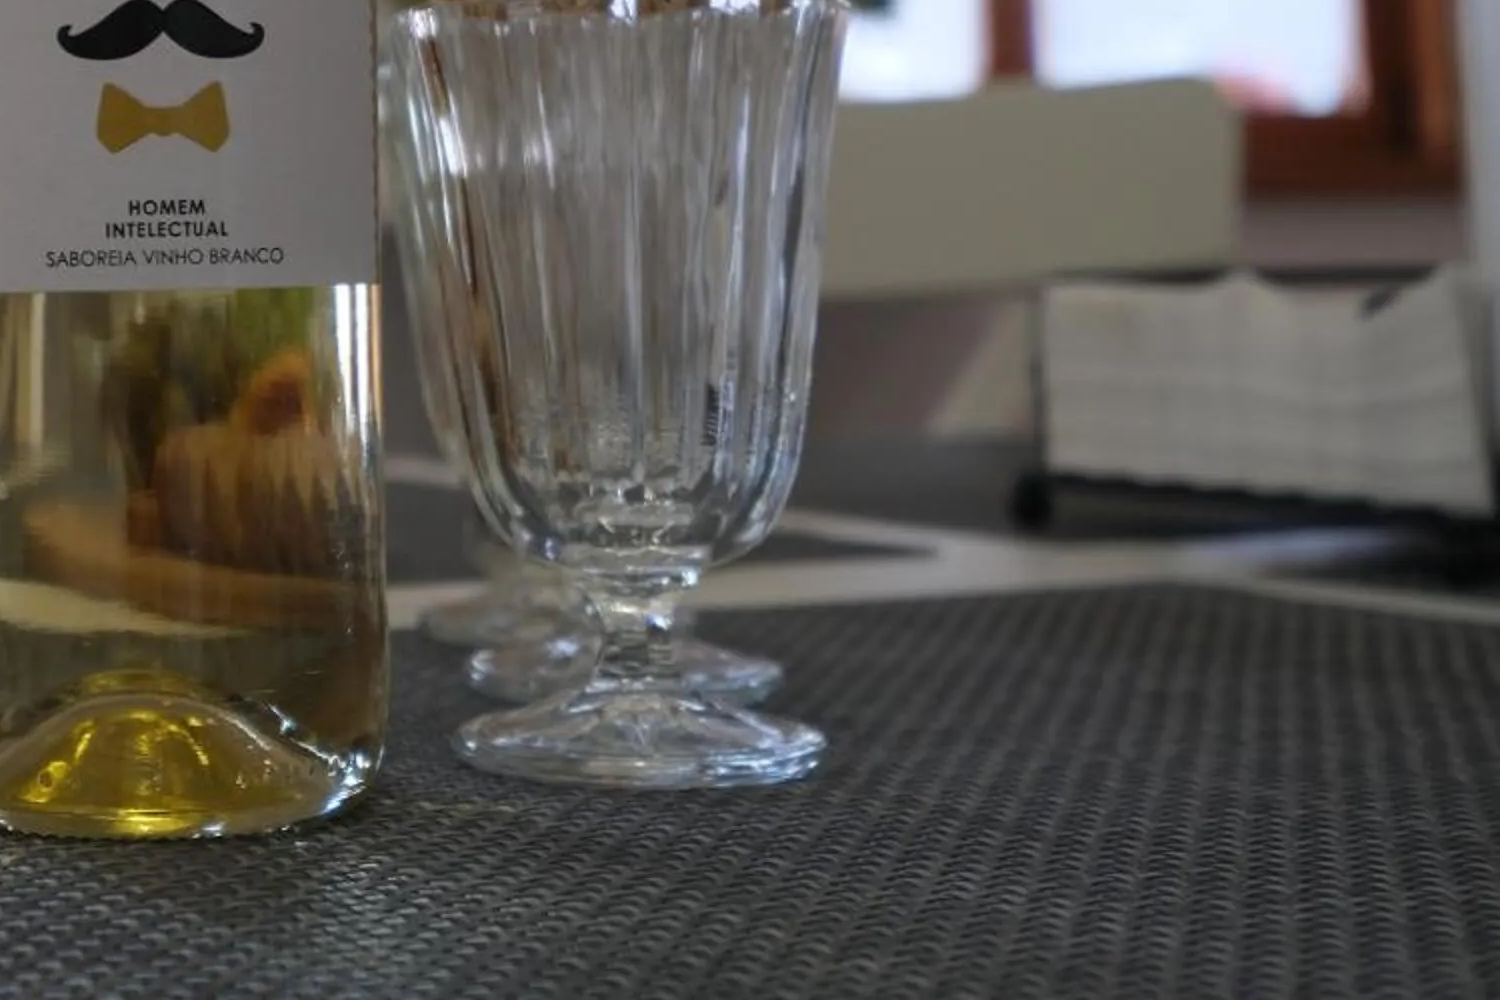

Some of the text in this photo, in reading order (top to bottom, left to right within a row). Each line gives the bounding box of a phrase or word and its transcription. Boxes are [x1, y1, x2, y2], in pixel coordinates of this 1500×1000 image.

[128, 199, 206, 217] HOMEM
[105, 220, 229, 239] INTELECTUAL
[45, 247, 285, 268] SABOREIA VINHO BRANCO
